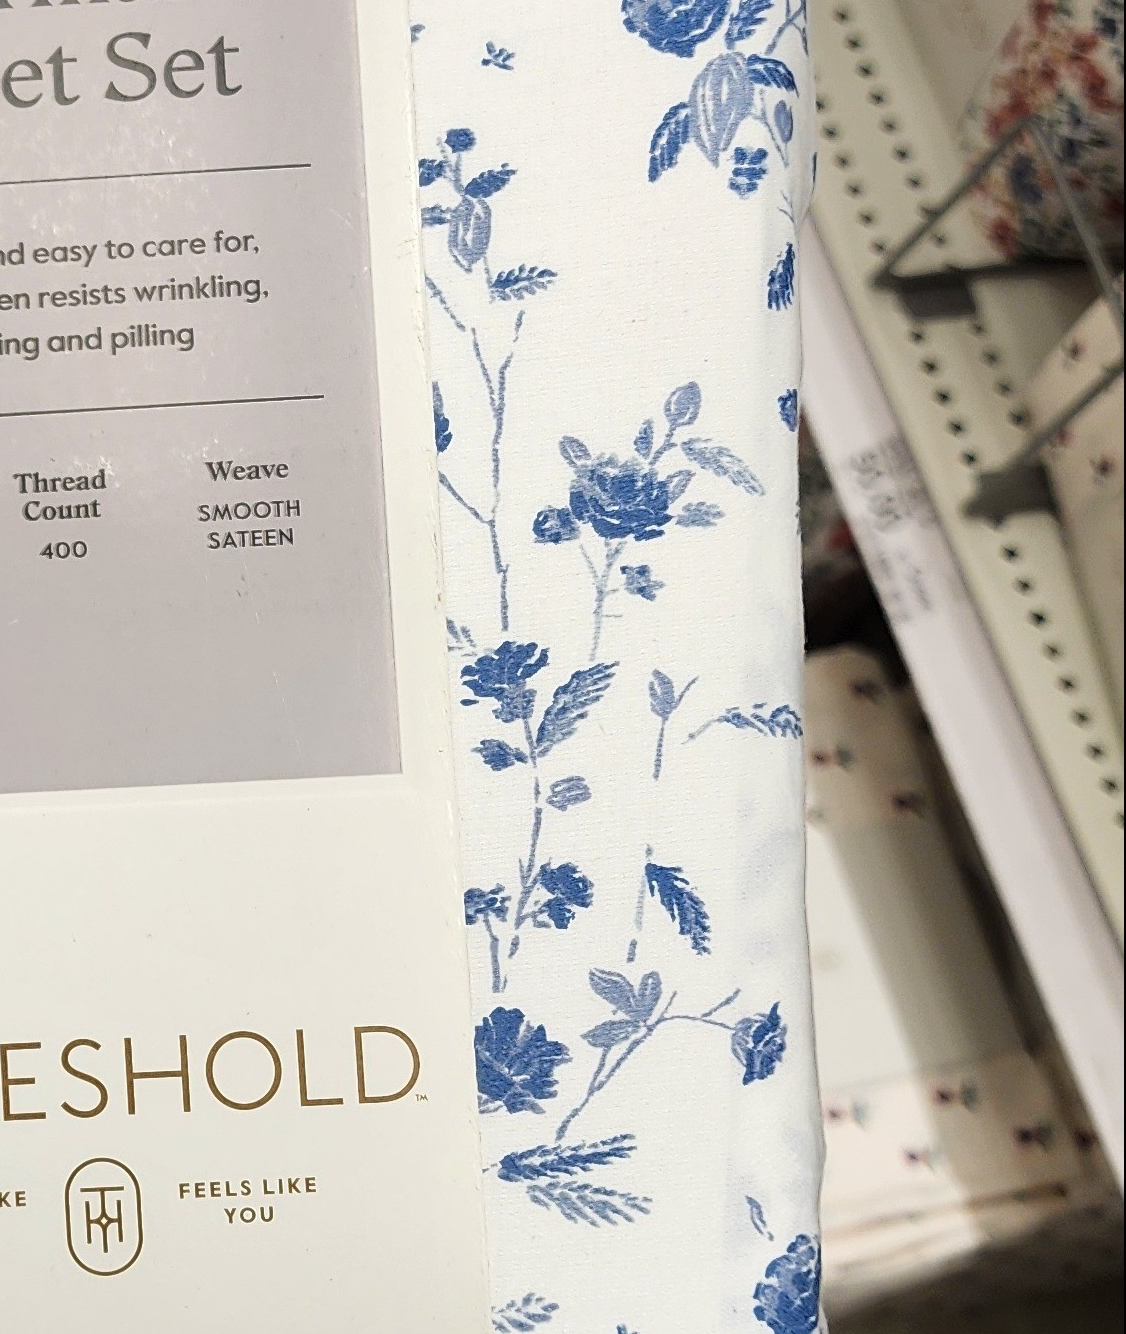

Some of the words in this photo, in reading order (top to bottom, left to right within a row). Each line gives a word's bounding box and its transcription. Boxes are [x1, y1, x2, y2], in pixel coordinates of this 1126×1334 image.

[103, 31, 243, 103] Set
[31, 243, 98, 268] easy
[103, 239, 135, 260] to
[141, 237, 207, 258] care
[213, 229, 260, 255] for,
[37, 282, 127, 309] resists
[131, 274, 269, 304] wrinkling,
[46, 326, 103, 353] and
[110, 322, 195, 354] pilling
[11, 468, 108, 495] Thread
[204, 459, 290, 482] Weave
[21, 498, 102, 522] Count
[196, 499, 301, 523] SMOOTH
[38, 540, 88, 560] 400
[206, 527, 294, 550] SATEEN
[178, 1179, 252, 1200] FEELS
[262, 1176, 317, 1196] LIKE
[223, 1205, 274, 1225] YOU
